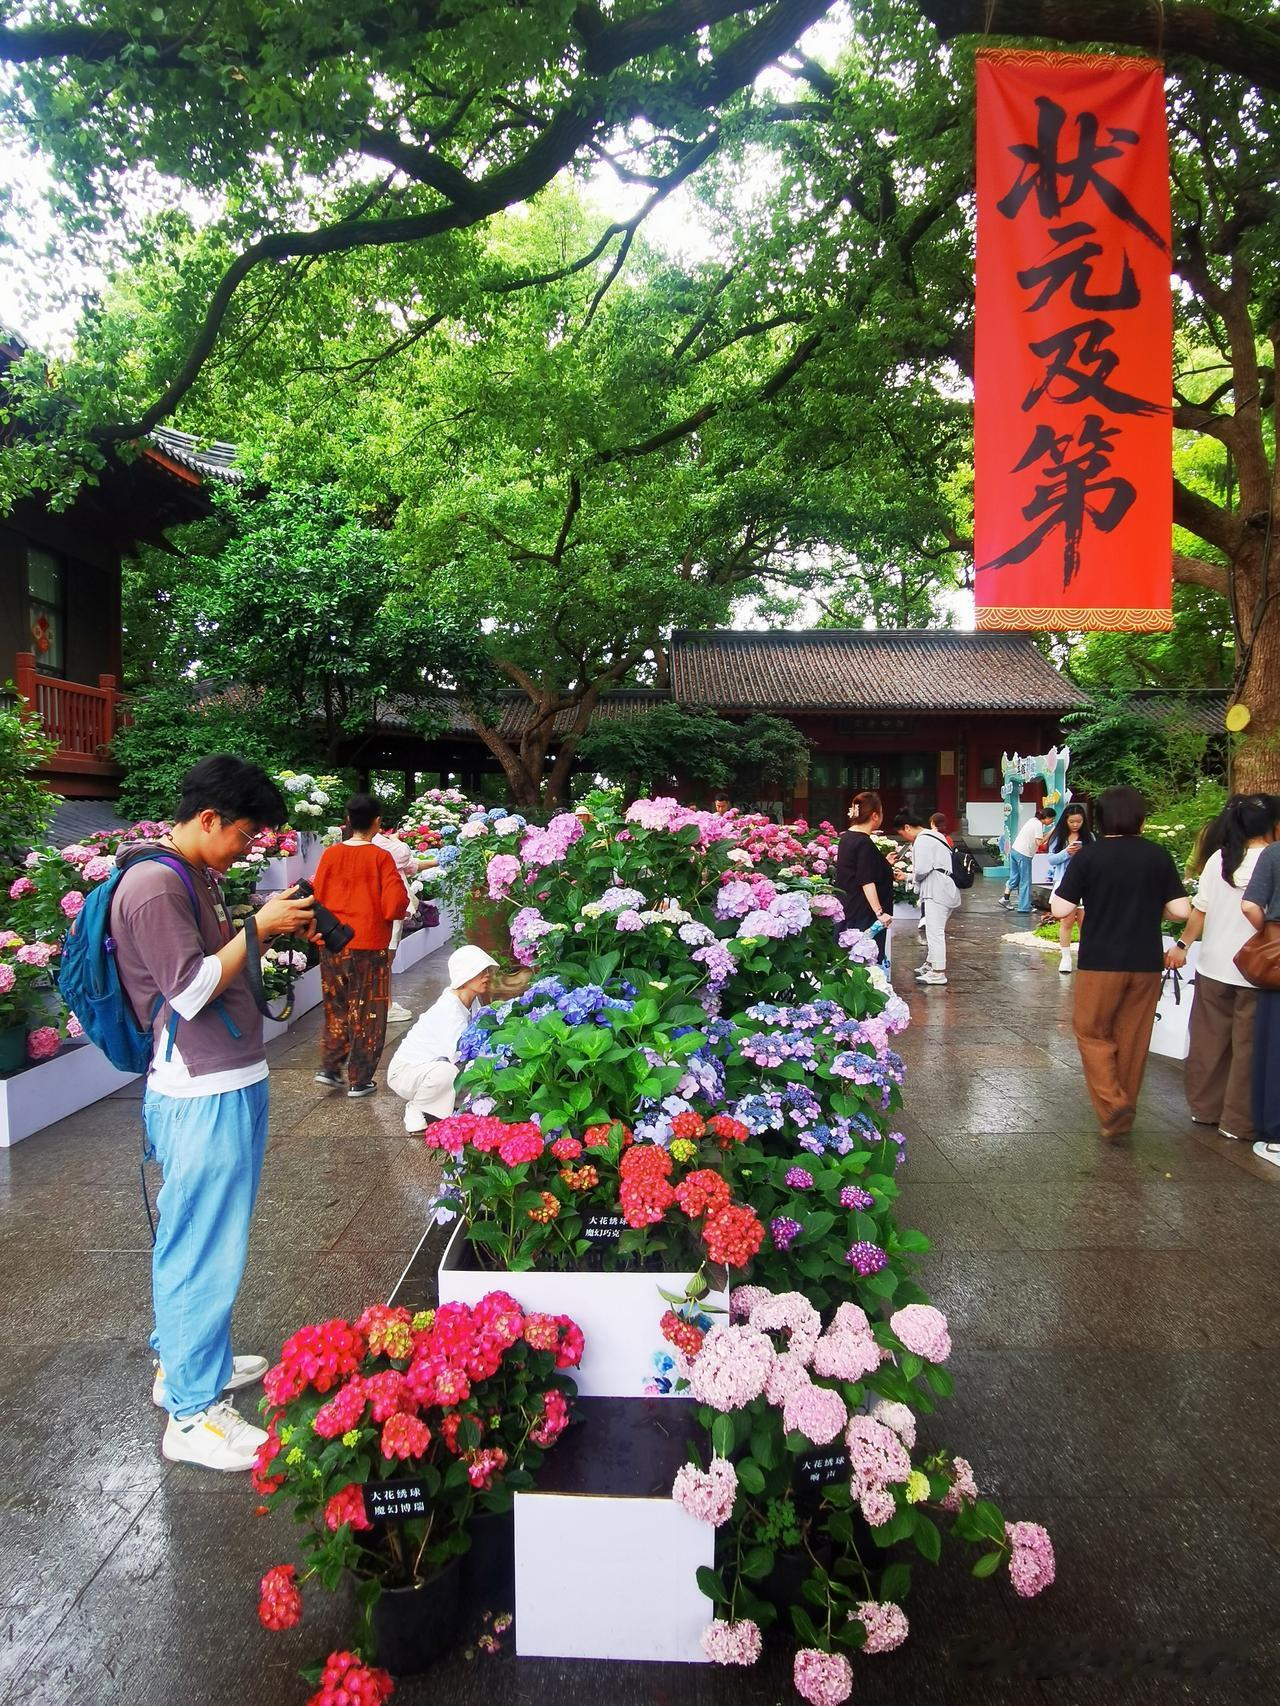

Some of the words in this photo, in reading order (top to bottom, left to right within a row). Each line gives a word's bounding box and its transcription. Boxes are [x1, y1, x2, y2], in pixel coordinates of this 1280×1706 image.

[975, 96, 1173, 595] 状元及第
[801, 1456, 846, 1471] 大花绣球
[371, 1487, 421, 1502] 大花绣球
[374, 1501, 425, 1516] 魔幻博瑞
